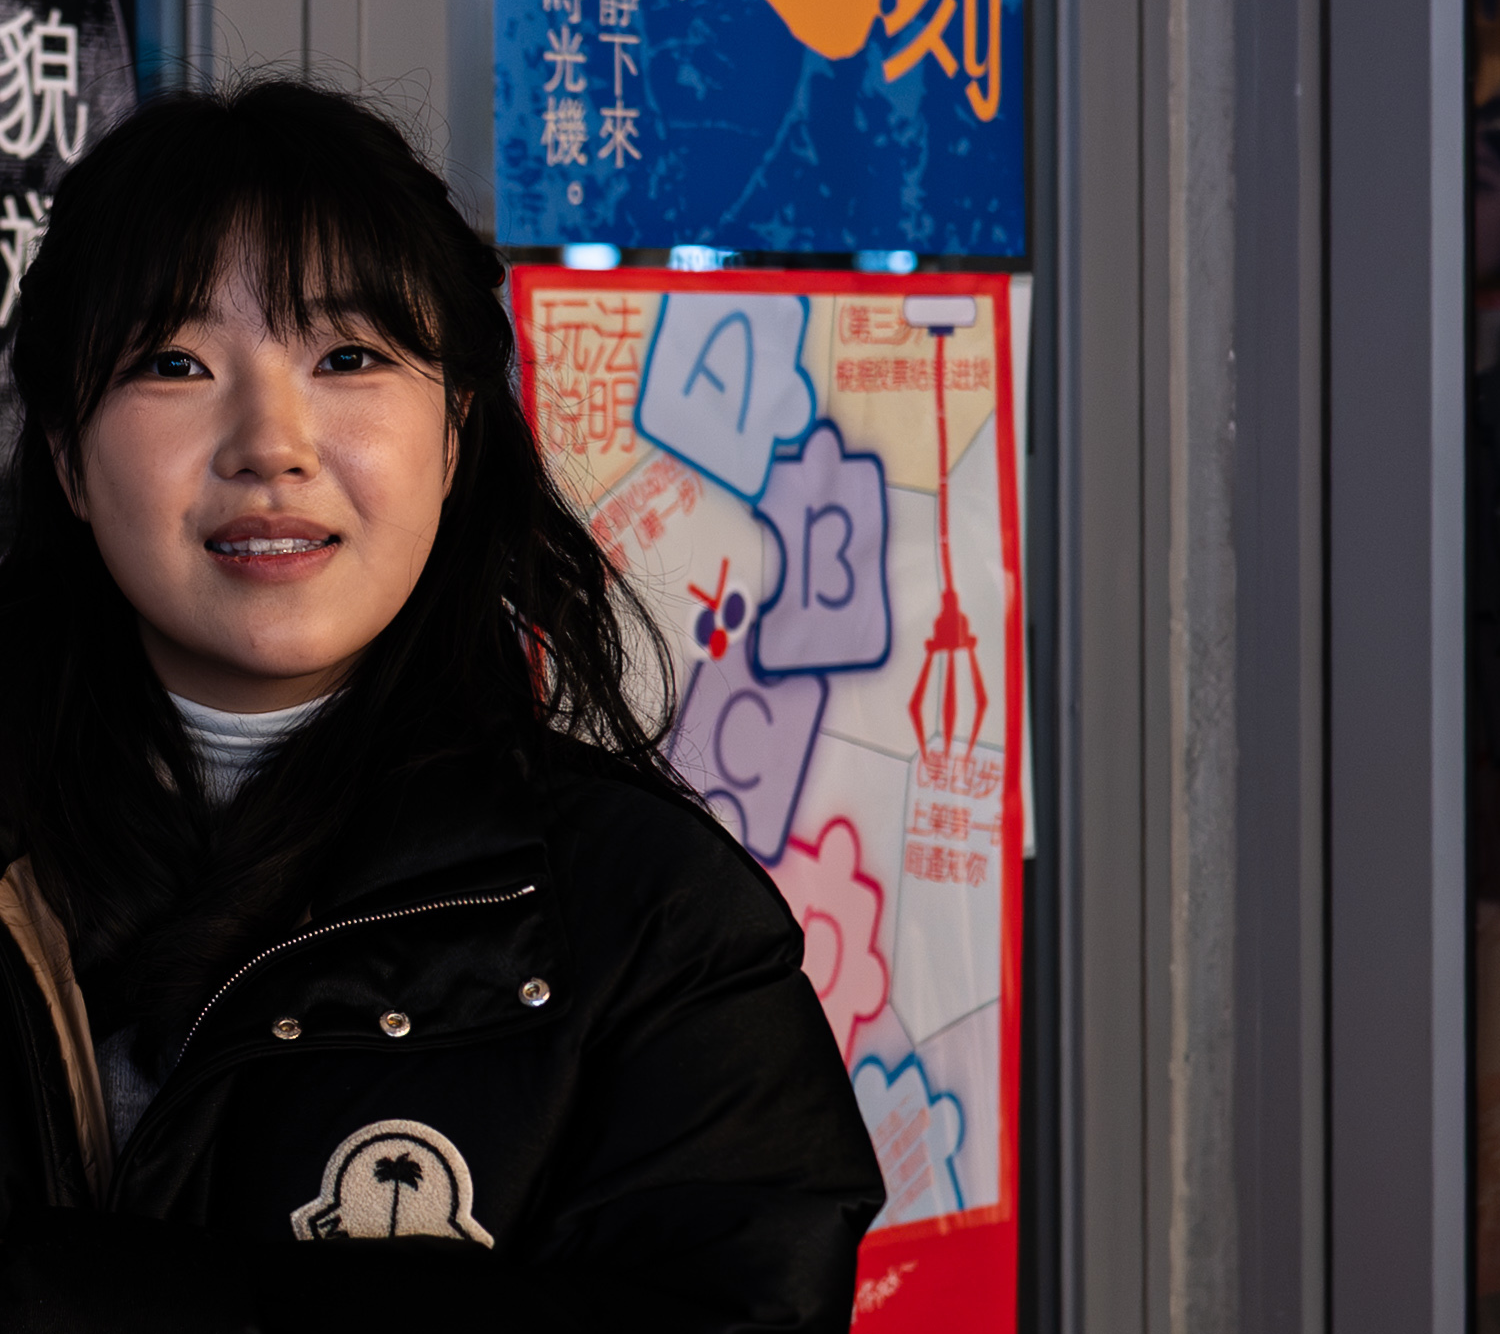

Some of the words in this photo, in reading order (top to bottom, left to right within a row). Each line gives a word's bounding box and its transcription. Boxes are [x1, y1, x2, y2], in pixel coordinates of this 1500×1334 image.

[539, 298, 644, 374] 玩法
[683, 310, 755, 434] A
[539, 378, 639, 455] 说明
[714, 689, 774, 790] C
